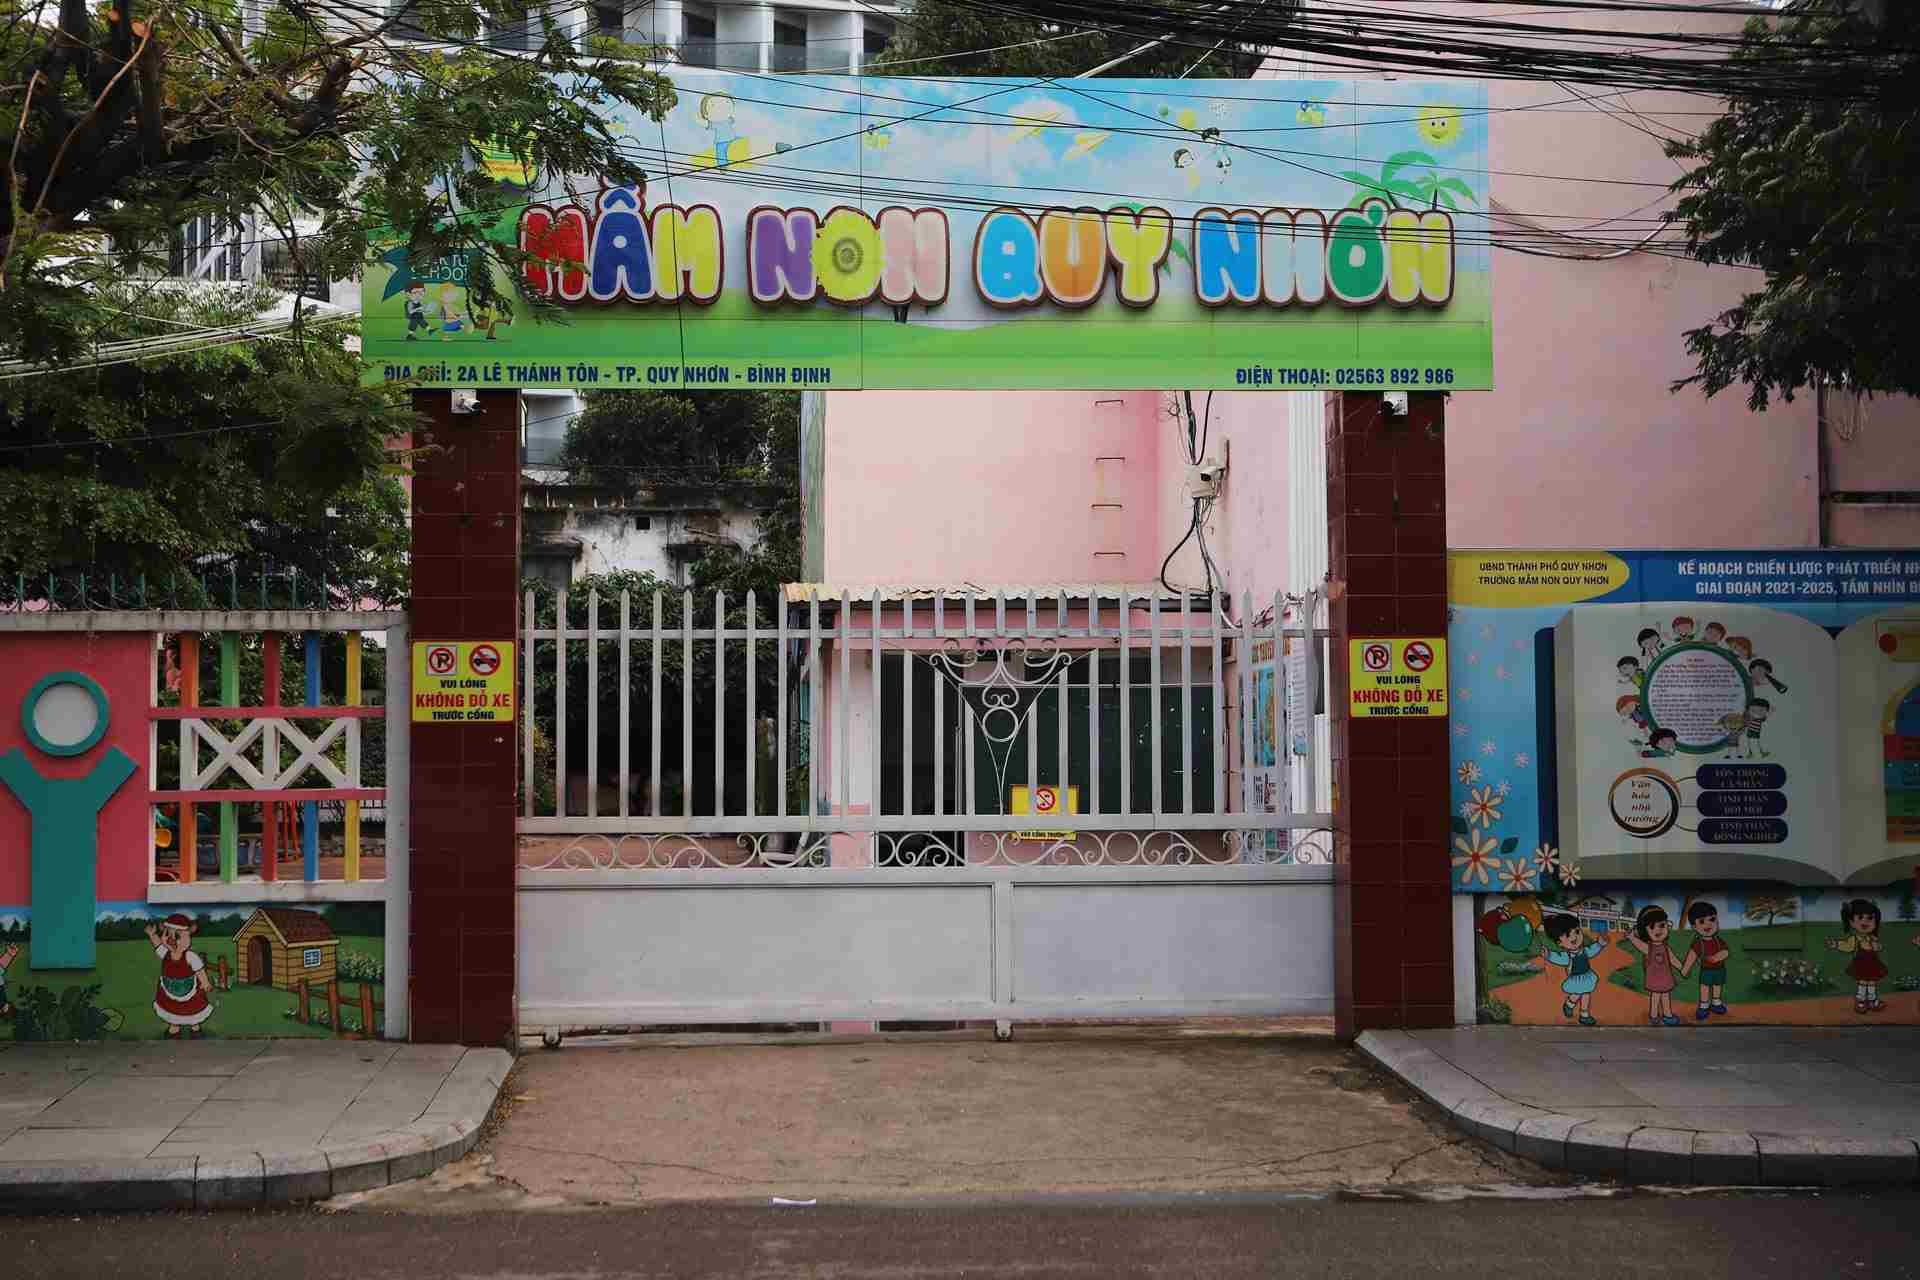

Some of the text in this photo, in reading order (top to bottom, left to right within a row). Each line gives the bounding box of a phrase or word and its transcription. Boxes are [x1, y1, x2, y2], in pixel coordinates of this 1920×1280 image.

[746, 205, 951, 305] NON
[973, 206, 1173, 308] QUY
[1194, 197, 1455, 308] NHƠN
[457, 366, 478, 382] 2A
[483, 361, 501, 382] LÊ
[508, 362, 561, 382] THÁNH
[567, 361, 598, 382] TÔN
[616, 366, 641, 383] TP.
[647, 366, 679, 384] QUY
[684, 364, 729, 383] NHƠN
[748, 362, 786, 383] BÌNH
[791, 366, 831, 386] ĐỊNH
[1236, 364, 1454, 387] ĐIỆN THOẠI: 02563 892 986
[1561, 561, 1580, 572] QUY
[1678, 558, 1696, 575] KẾ
[1699, 561, 1743, 577] HOẠCH
[1747, 557, 1785, 575] CHIẾN
[1789, 561, 1823, 577] LƯỢC
[1827, 559, 1860, 575] PHÁT
[1863, 556, 1901, 575] TRIỂN
[1541, 575, 1561, 585] NON
[1562, 575, 1581, 586] QUY
[1696, 581, 1722, 595] GIAI
[1726, 581, 1762, 597] ĐOẠN
[1873, 578, 1906, 595] NHÌN
[440, 677, 487, 689] VUI LÒNG
[1375, 675, 1392, 685] VUI
[416, 691, 464, 708] KHÔNG
[494, 693, 512, 708] XE
[1353, 687, 1400, 703] KHÔNG
[1427, 688, 1444, 703] XE
